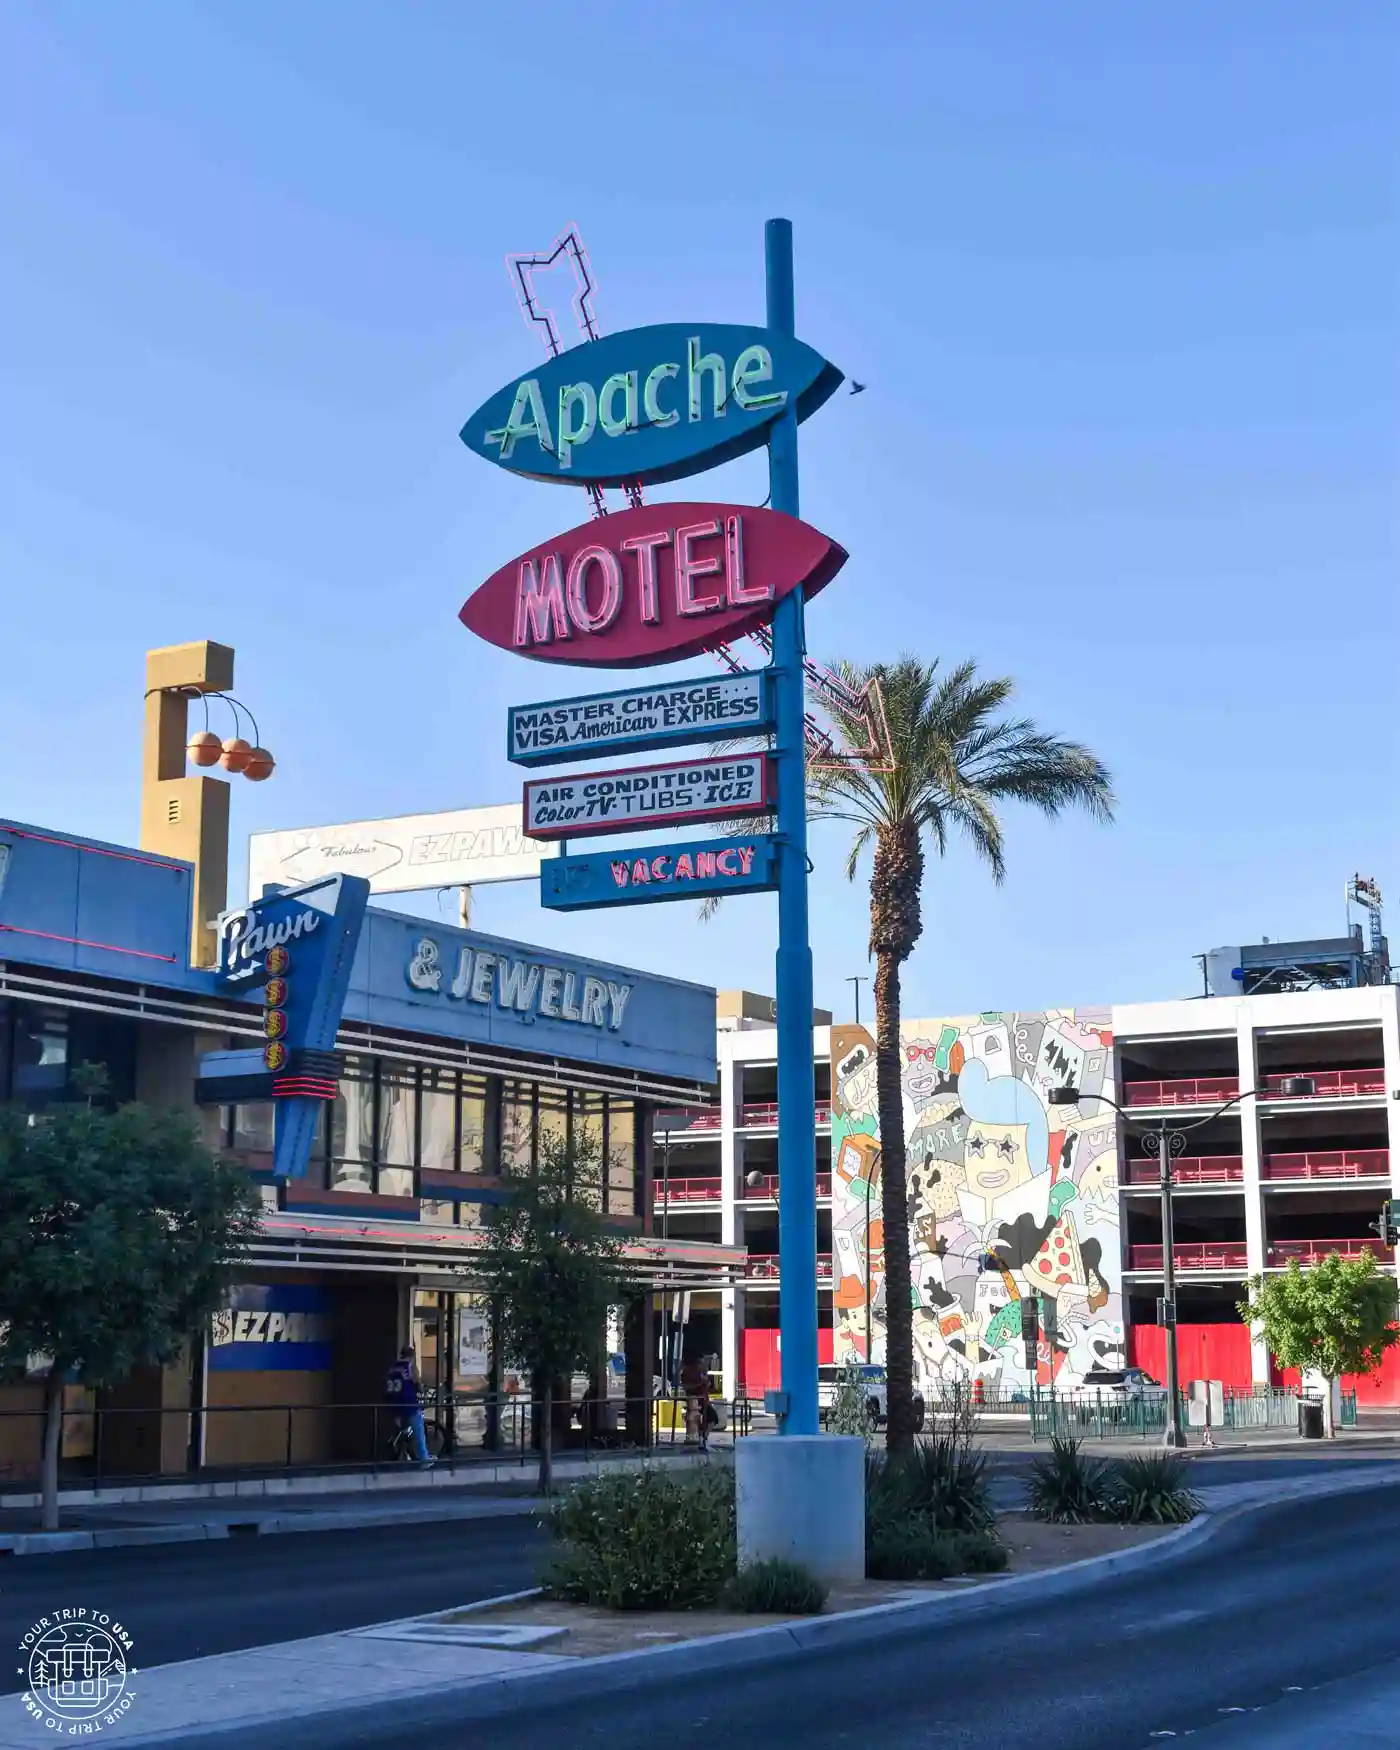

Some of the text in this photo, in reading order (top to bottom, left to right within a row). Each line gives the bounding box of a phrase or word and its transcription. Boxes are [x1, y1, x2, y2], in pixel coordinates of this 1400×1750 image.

[484, 336, 788, 469] Apache
[512, 513, 775, 648] MOTEL
[515, 703, 615, 731] MASTER
[515, 696, 759, 749] VISA American EXPRESS
[534, 804, 586, 825] Color
[620, 788, 693, 813] TUBS
[703, 780, 754, 804] ICE
[536, 765, 755, 804] AIR CONDITIONED
[321, 844, 377, 858] Fabulous
[611, 845, 756, 888] VACANCY
[222, 909, 320, 967] Pawn
[451, 947, 629, 1031] JEWELRY
[908, 1123, 964, 1161] MORE
